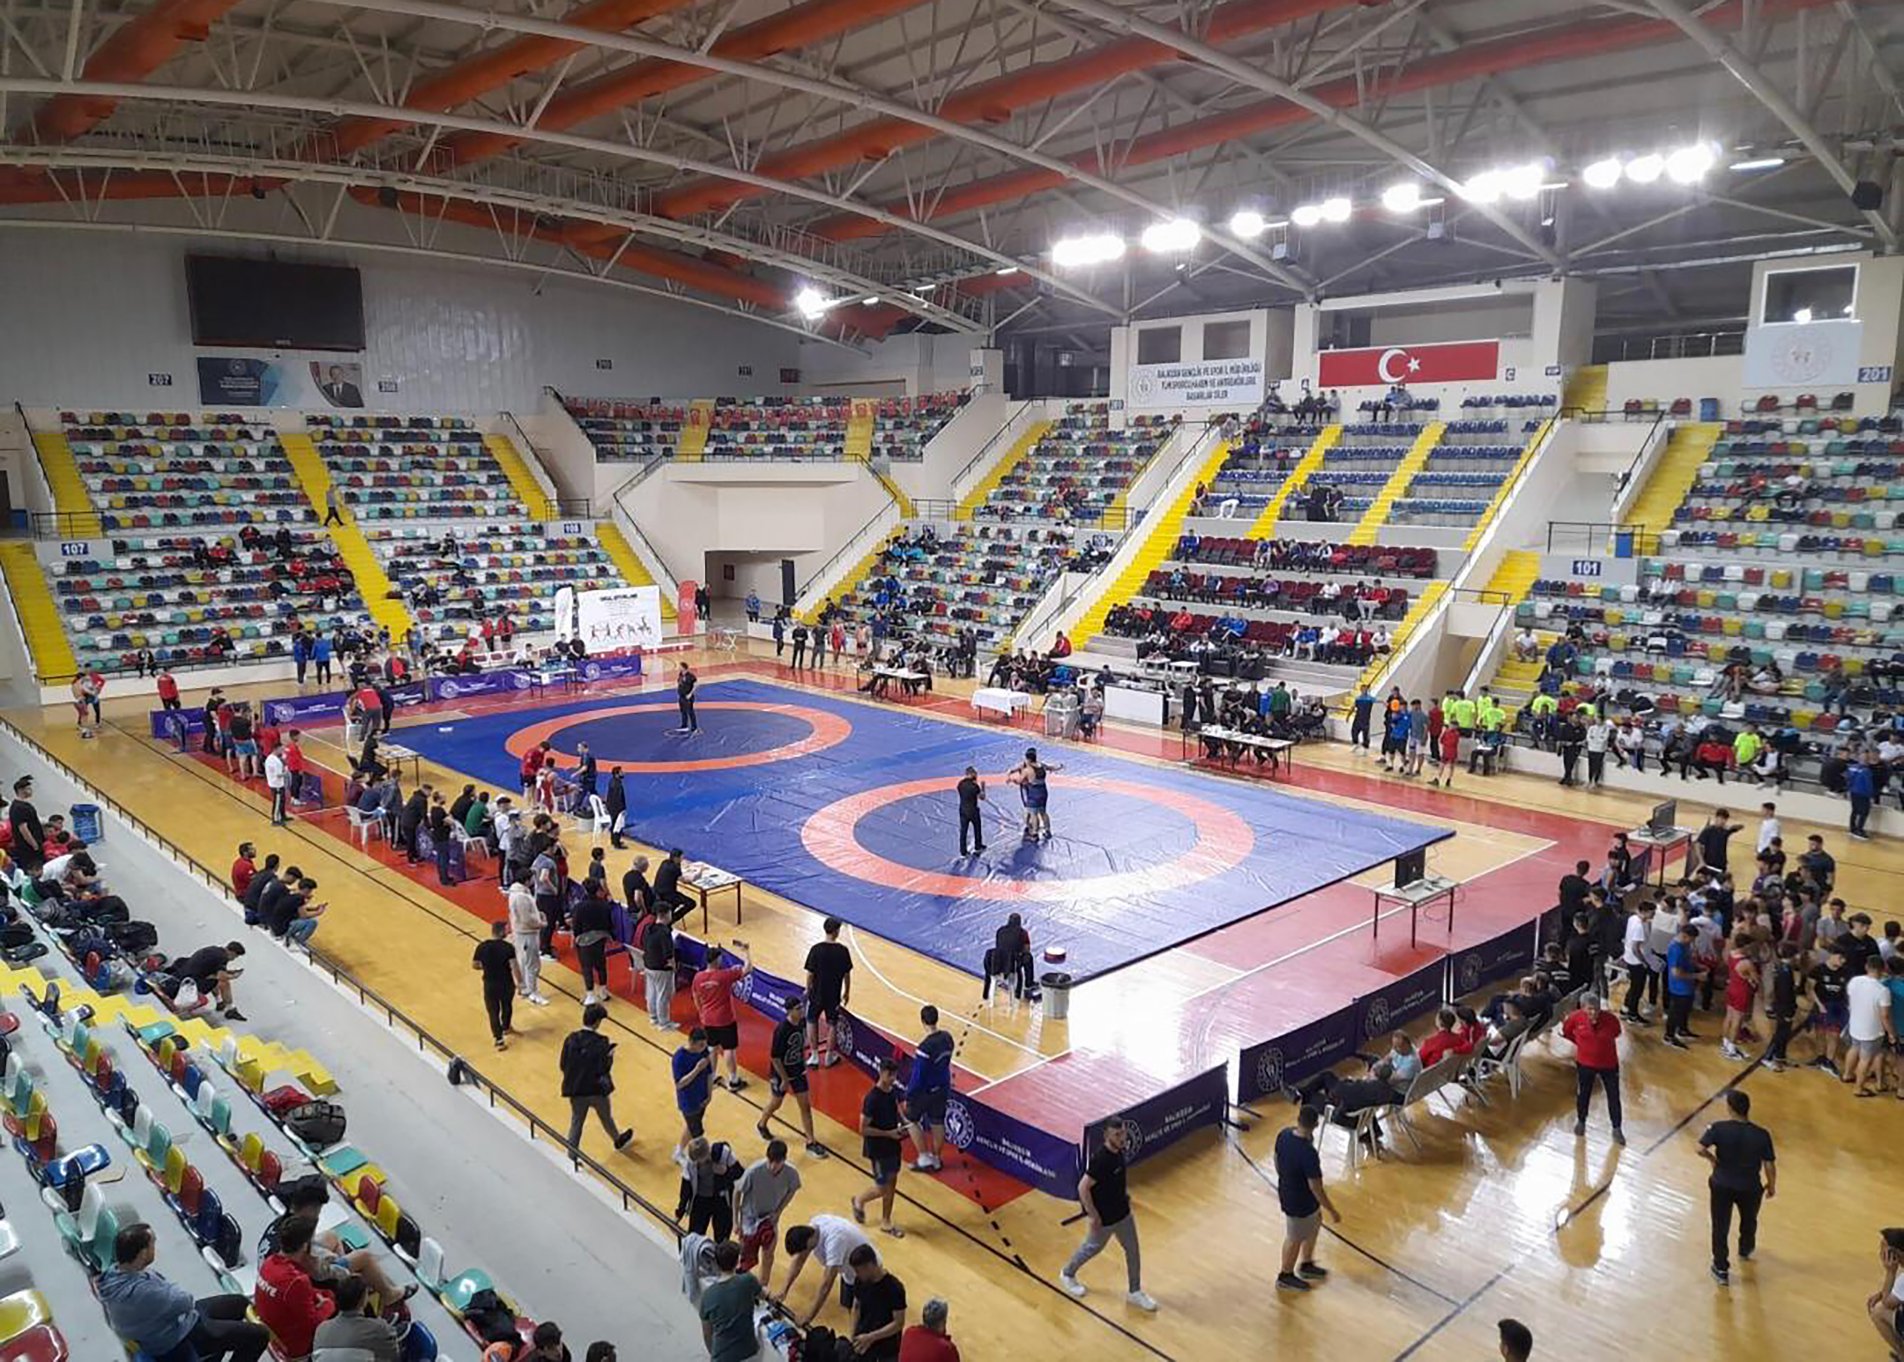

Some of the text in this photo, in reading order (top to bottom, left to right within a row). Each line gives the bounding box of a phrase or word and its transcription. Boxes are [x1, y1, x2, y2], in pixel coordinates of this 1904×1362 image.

[1861, 369, 1889, 381] 201
[64, 543, 85, 555] 107
[1576, 561, 1598, 575] 101
